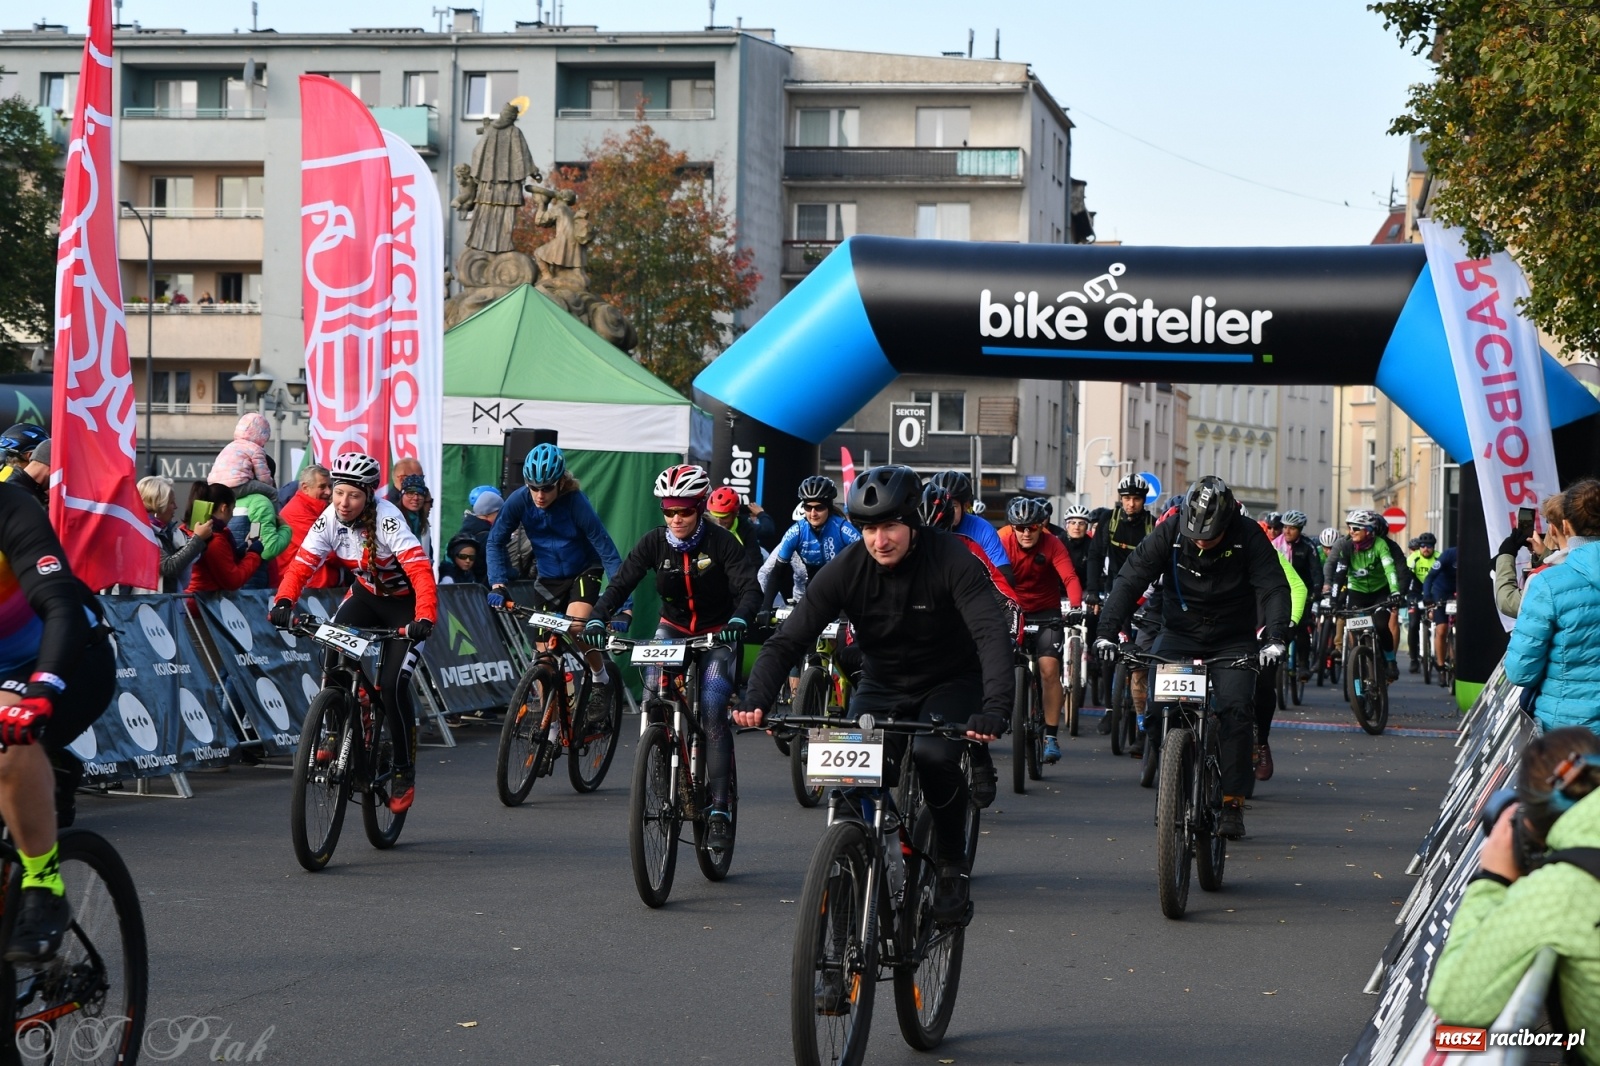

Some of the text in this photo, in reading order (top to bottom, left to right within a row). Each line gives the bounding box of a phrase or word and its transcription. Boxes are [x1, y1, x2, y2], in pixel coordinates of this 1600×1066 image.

[980, 289, 1273, 345] bike atelier
[895, 408, 925, 416] SEKTOR
[898, 417, 921, 448] 0
[160, 458, 213, 478] MAT
[1198, 486, 1212, 508] FOX
[537, 616, 564, 628] 3286
[325, 629, 358, 648] 2226
[642, 648, 678, 658] 3247
[1162, 679, 1196, 692] 2151
[134, 753, 178, 769] KOKOwear
[820, 750, 871, 768] 2692
